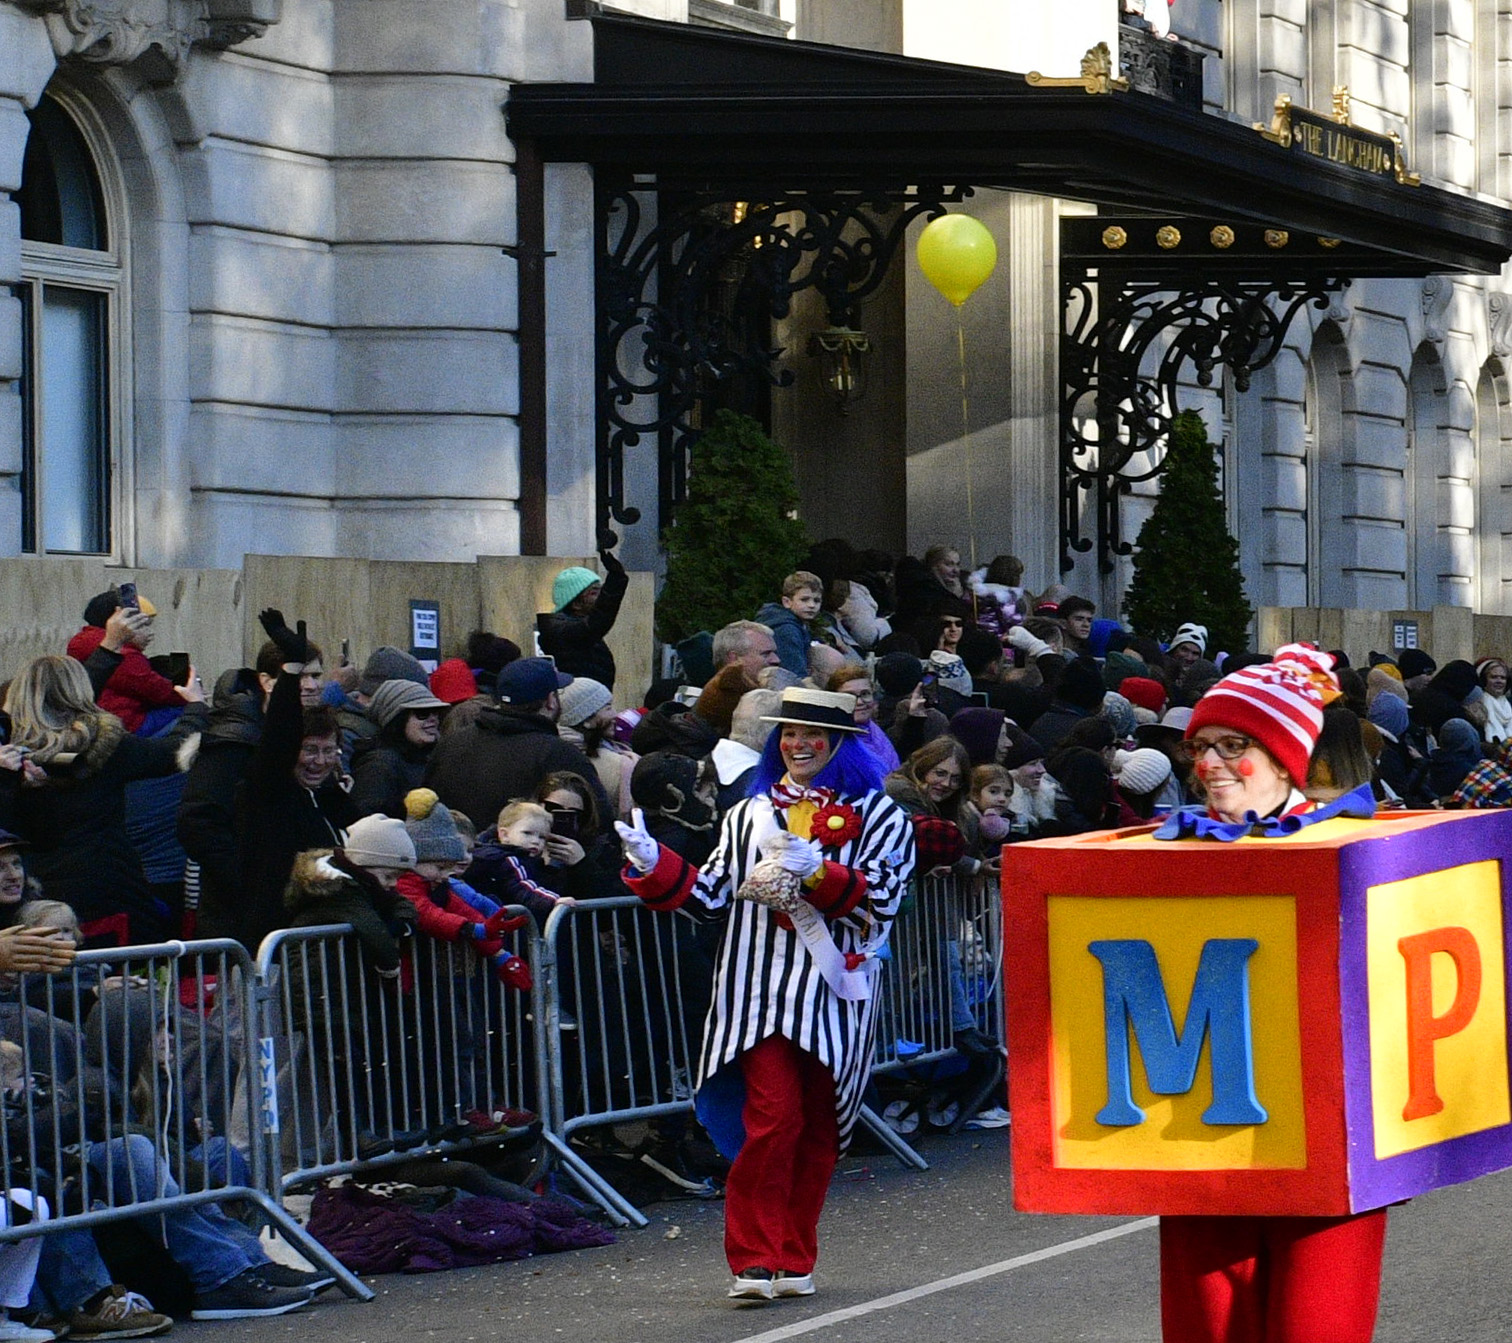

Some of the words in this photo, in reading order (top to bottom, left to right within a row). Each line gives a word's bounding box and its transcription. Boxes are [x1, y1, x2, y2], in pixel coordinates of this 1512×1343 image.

[260, 1039, 276, 1128] NYPD
[1087, 938, 1269, 1126] M
[1397, 925, 1483, 1122] P
